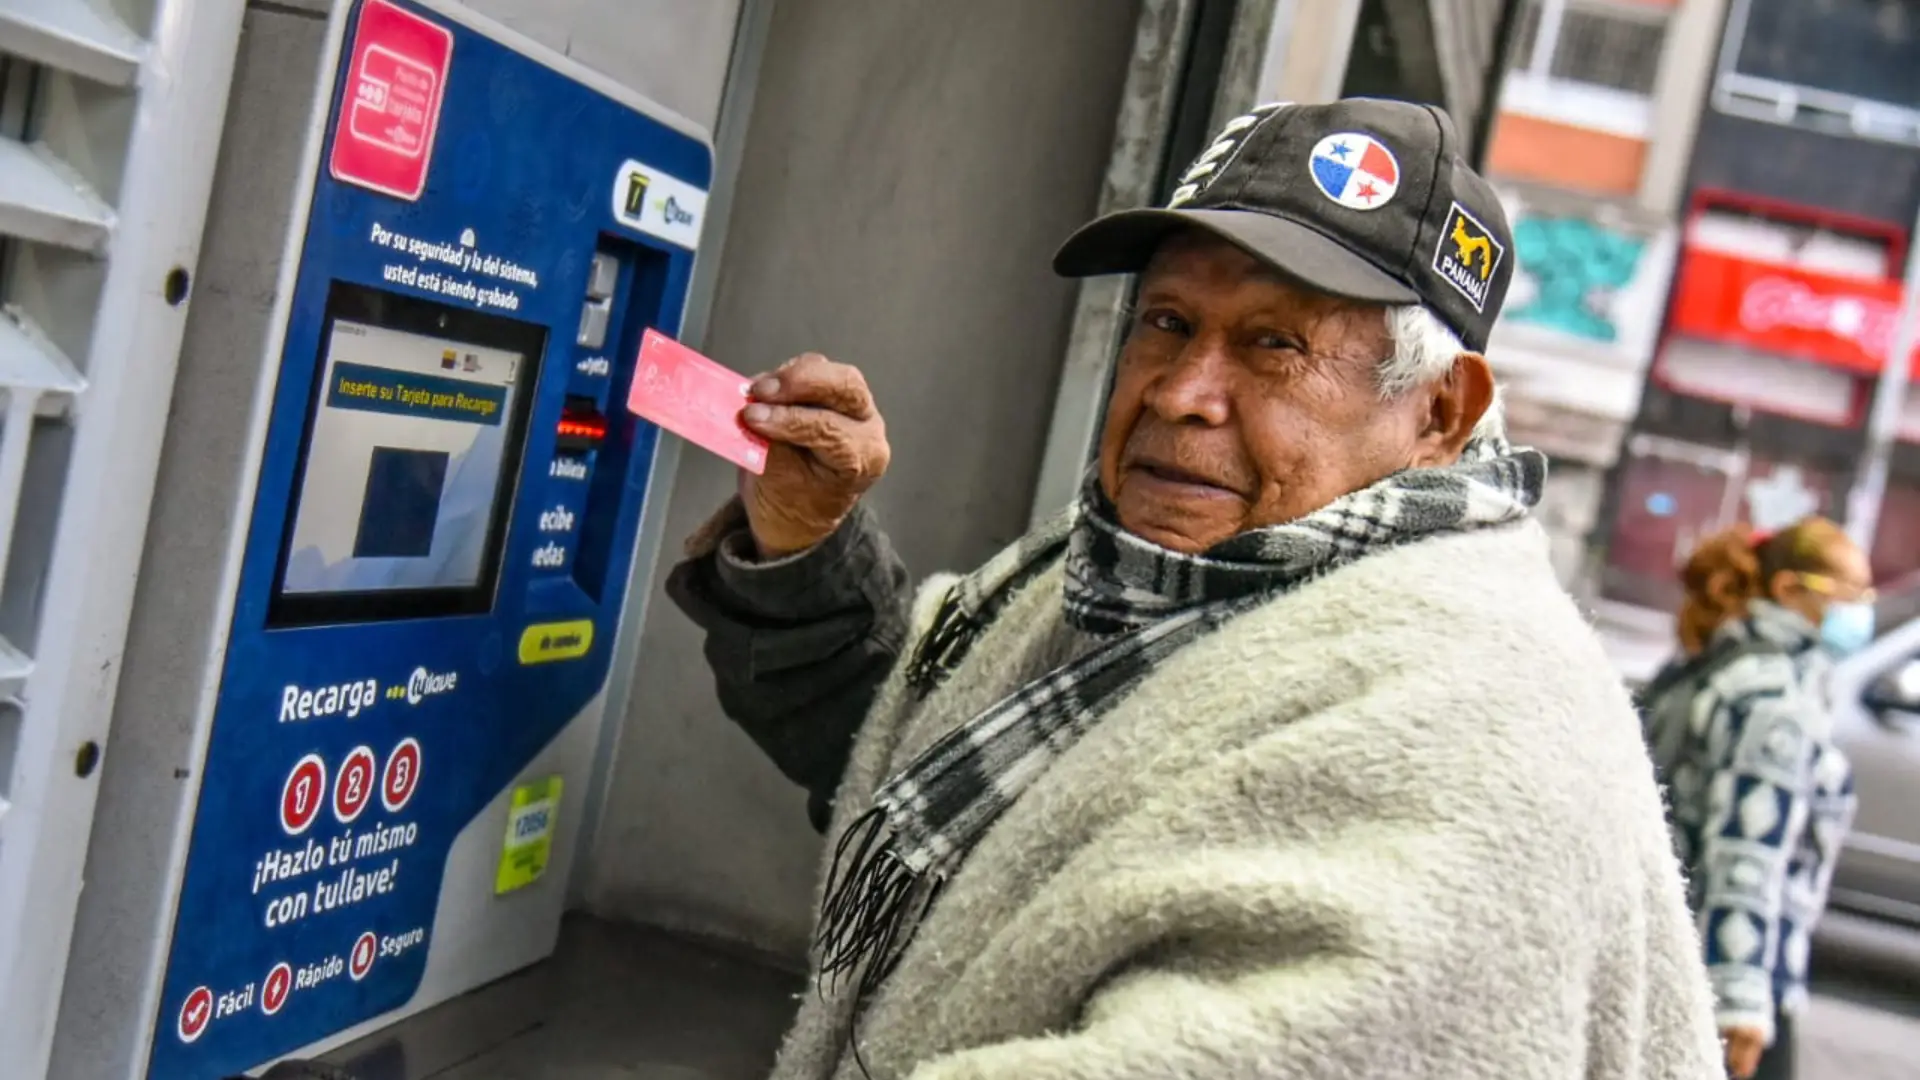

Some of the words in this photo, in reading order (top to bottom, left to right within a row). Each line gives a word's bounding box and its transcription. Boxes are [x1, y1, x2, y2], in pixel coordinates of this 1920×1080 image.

[370, 221, 392, 247] Por
[393, 231, 408, 251] su
[408, 238, 463, 263] seguridad
[462, 254, 473, 272] y
[472, 250, 483, 271] la
[482, 256, 501, 276] del
[500, 260, 539, 290] sistema,
[383, 264, 418, 287] usted
[417, 271, 441, 294] está
[441, 275, 477, 302] siendo
[476, 286, 520, 311] grabado
[338, 378, 378, 399] Inserte
[379, 386, 394, 401] su
[396, 384, 431, 408] Tarjeta
[431, 393, 455, 411] para
[455, 392, 498, 417] Recargar
[278, 678, 377, 723] Recarga
[295, 775, 312, 814] 1
[344, 765, 363, 805] 2
[392, 755, 409, 793] 3
[252, 837, 324, 894] ¡Hazlo
[328, 828, 353, 864] tú
[354, 820, 418, 859] mismo
[264, 891, 308, 928] con
[313, 858, 399, 914] tullave!
[215, 982, 255, 1019] Fácil
[294, 955, 343, 990] Rápido
[378, 927, 424, 957] Seguro
